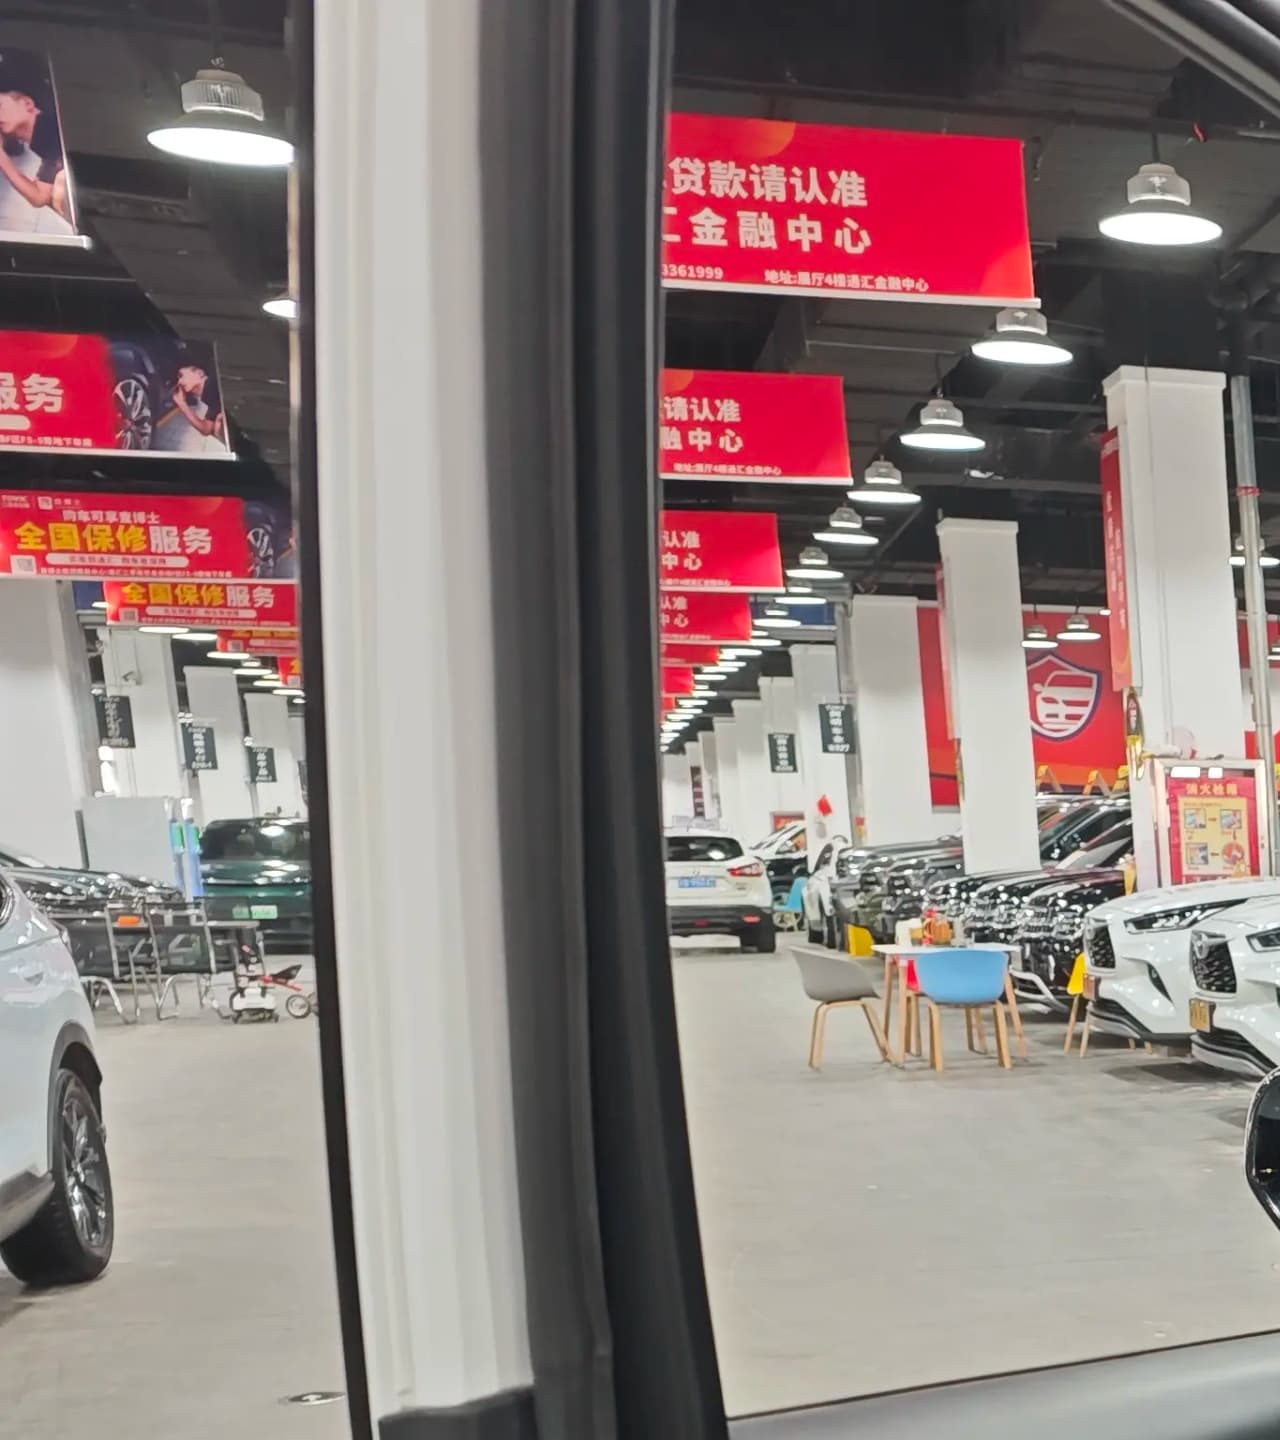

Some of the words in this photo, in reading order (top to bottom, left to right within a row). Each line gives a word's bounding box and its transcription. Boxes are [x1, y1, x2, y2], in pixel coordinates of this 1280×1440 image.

[14, 521, 213, 554] 全国保修服务
[121, 582, 275, 609] 全国保修服务
